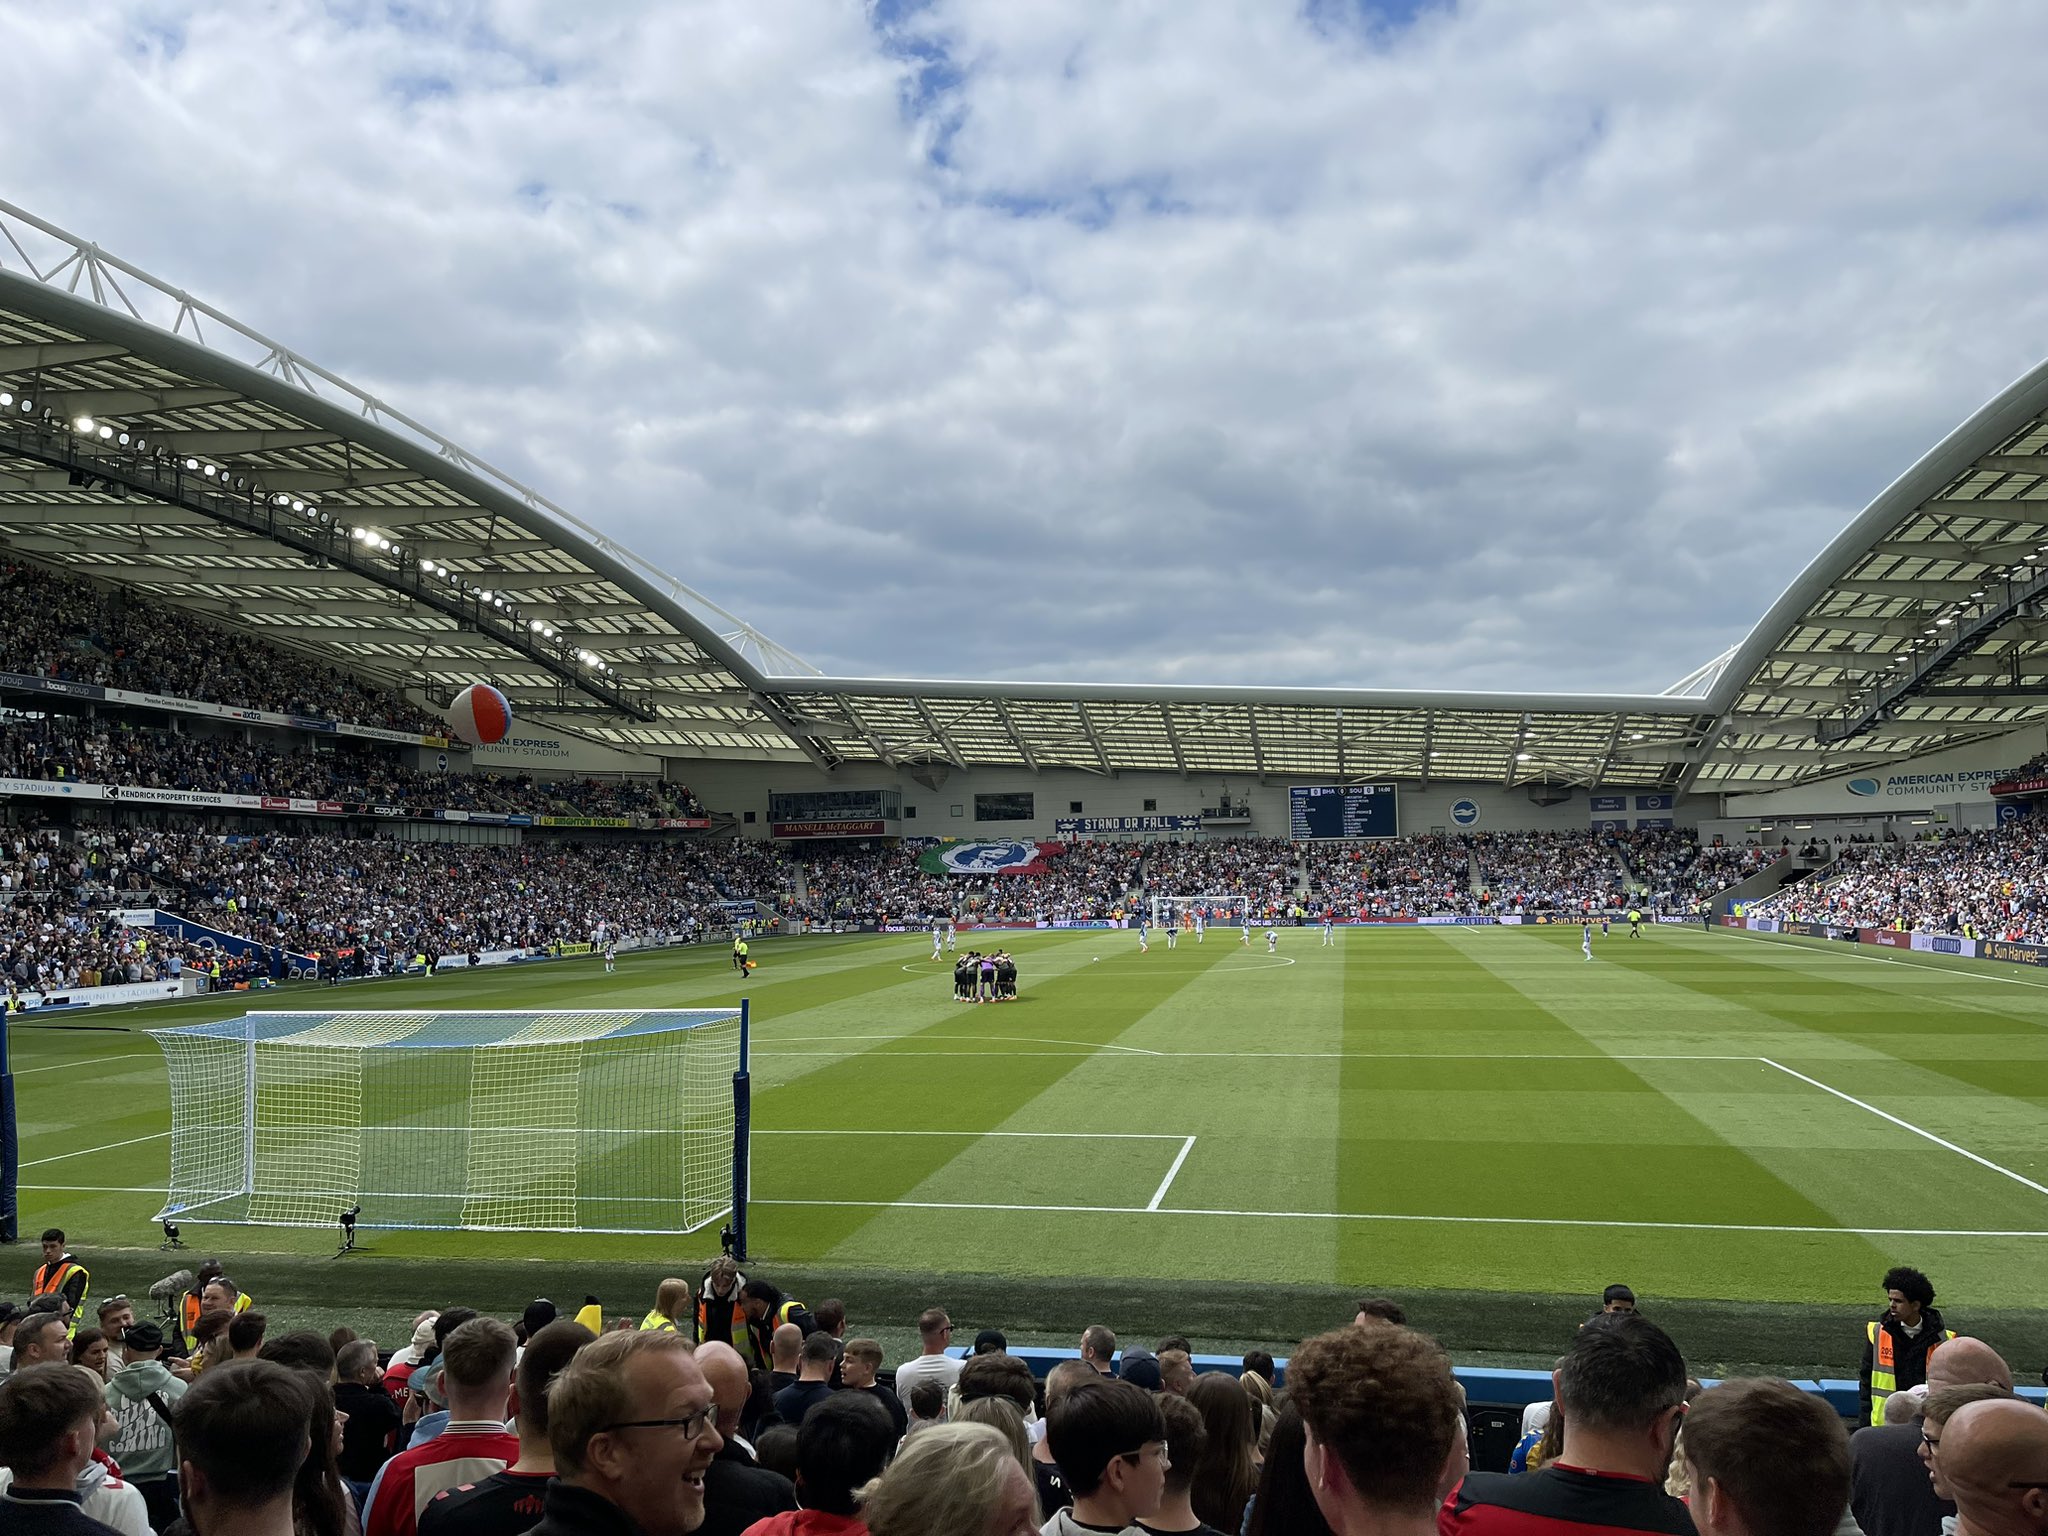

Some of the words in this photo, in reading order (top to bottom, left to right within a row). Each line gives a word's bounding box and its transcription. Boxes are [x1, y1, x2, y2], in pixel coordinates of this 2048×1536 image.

[242, 710, 261, 721] axtra
[513, 739, 560, 750] EXPRESS
[523, 748, 570, 758] STADIUM
[1887, 773, 1954, 787] AMERICAN
[13, 782, 56, 793] STADIUM
[1886, 783, 1966, 797] COMMUNITY
[121, 790, 155, 800] KENDRICK
[156, 792, 190, 802] PROPERTY
[191, 795, 222, 804] SERVICES
[553, 817, 592, 827] BRIGHTON
[593, 818, 617, 827] TOOLS
[671, 819, 688, 828] Rex
[1085, 818, 1120, 830] STAND
[1124, 818, 1138, 829] OR
[1143, 816, 1172, 828] FALL
[784, 823, 824, 833] MANSELL
[1457, 917, 1494, 925] SOLUTION
[1551, 916, 1570, 925] Sun
[1572, 915, 1612, 925] Harvest
[1994, 943, 2008, 959] Sun
[2008, 945, 2039, 963] Harvest
